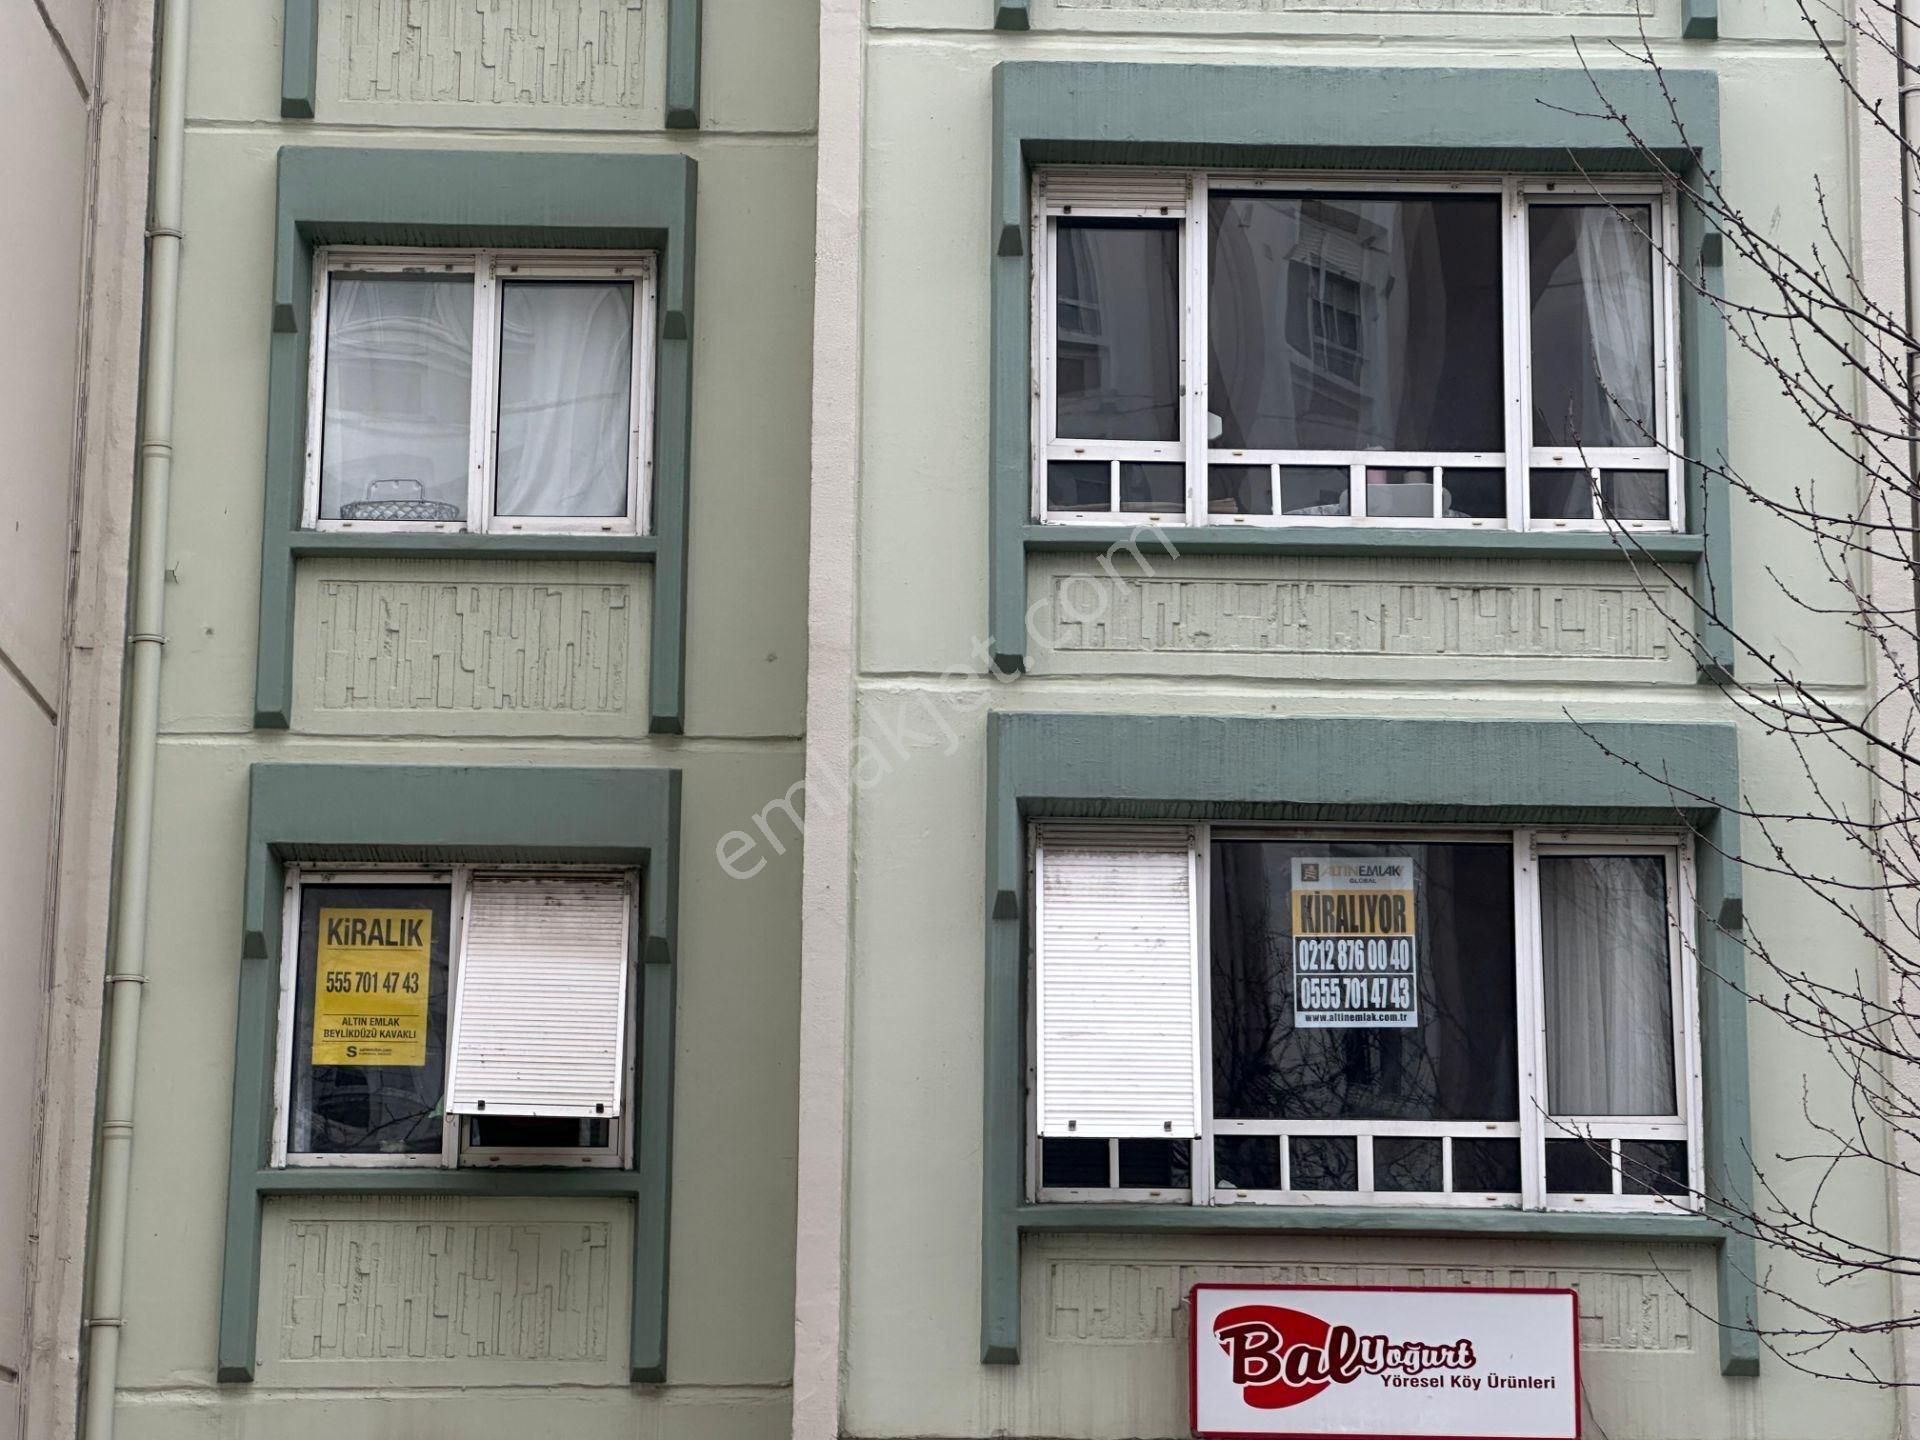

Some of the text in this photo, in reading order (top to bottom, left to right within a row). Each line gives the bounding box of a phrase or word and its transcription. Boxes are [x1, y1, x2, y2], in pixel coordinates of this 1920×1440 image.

[1300, 891, 1407, 933] KİRALIYOR
[1300, 939, 1410, 970] 0212 876 00 40
[326, 971, 419, 993] 555 701 47 43
[1301, 978, 1410, 1009] 0555 701 47 43
[341, 1017, 400, 1026] ALTIN EMLAK
[1305, 1013, 1408, 1022] www.altinemlak.com.tr
[323, 1028, 416, 1039] BEYLİKDÜZÜ KAVAKLI
[1219, 1324, 1477, 1385] Bal Yoğurt
[1380, 1373, 1556, 1391] Yöresel Köy Ürünleri
